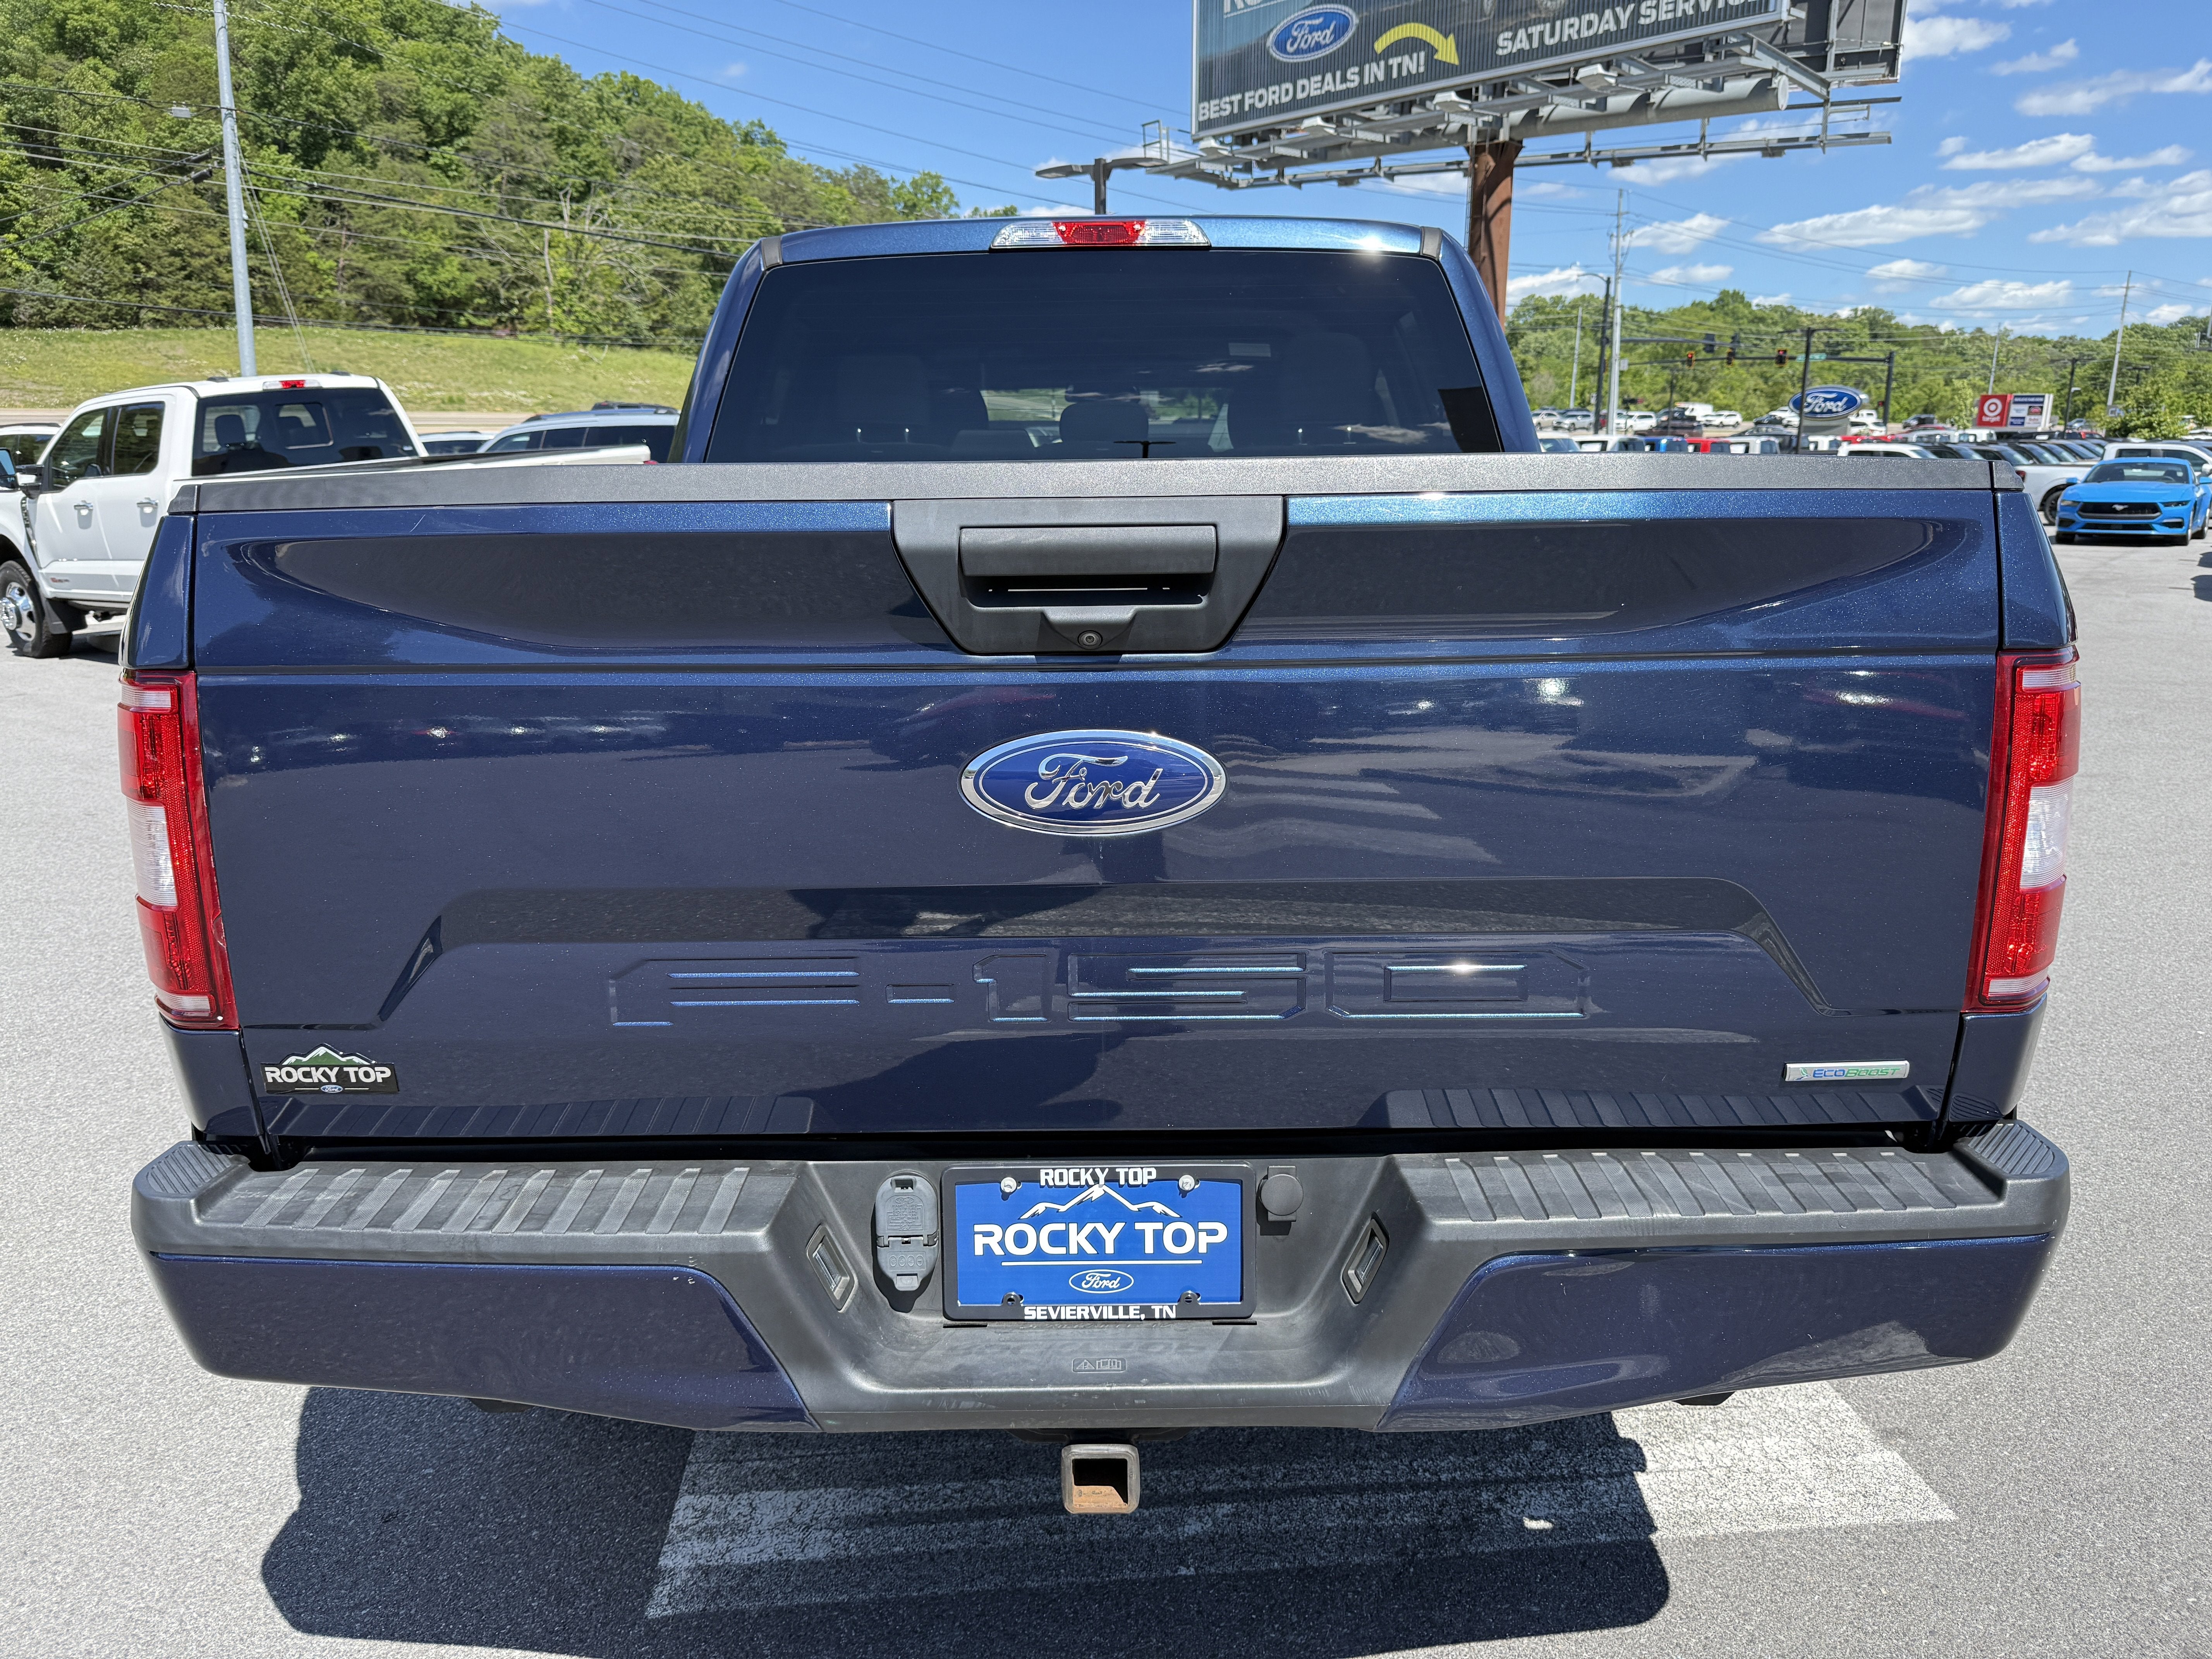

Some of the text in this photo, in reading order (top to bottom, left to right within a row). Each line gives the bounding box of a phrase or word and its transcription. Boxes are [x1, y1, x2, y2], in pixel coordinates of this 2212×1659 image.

[1286, 17, 1336, 53] Ford
[1496, 0, 1758, 56] SATURDAY SERV
[1199, 51, 1426, 122] BEST FORD DEALS IN TN!
[1803, 392, 1848, 413] Ford
[1024, 753, 1163, 810] Ford
[265, 1066, 391, 1083] ROCKY TOP
[1040, 1167, 1157, 1186] ROCKY TOP
[974, 1221, 1228, 1255] ROCKY TOP
[1081, 1273, 1121, 1289] Ford
[1024, 1305, 1177, 1321] SEVIERVILLE, TN
